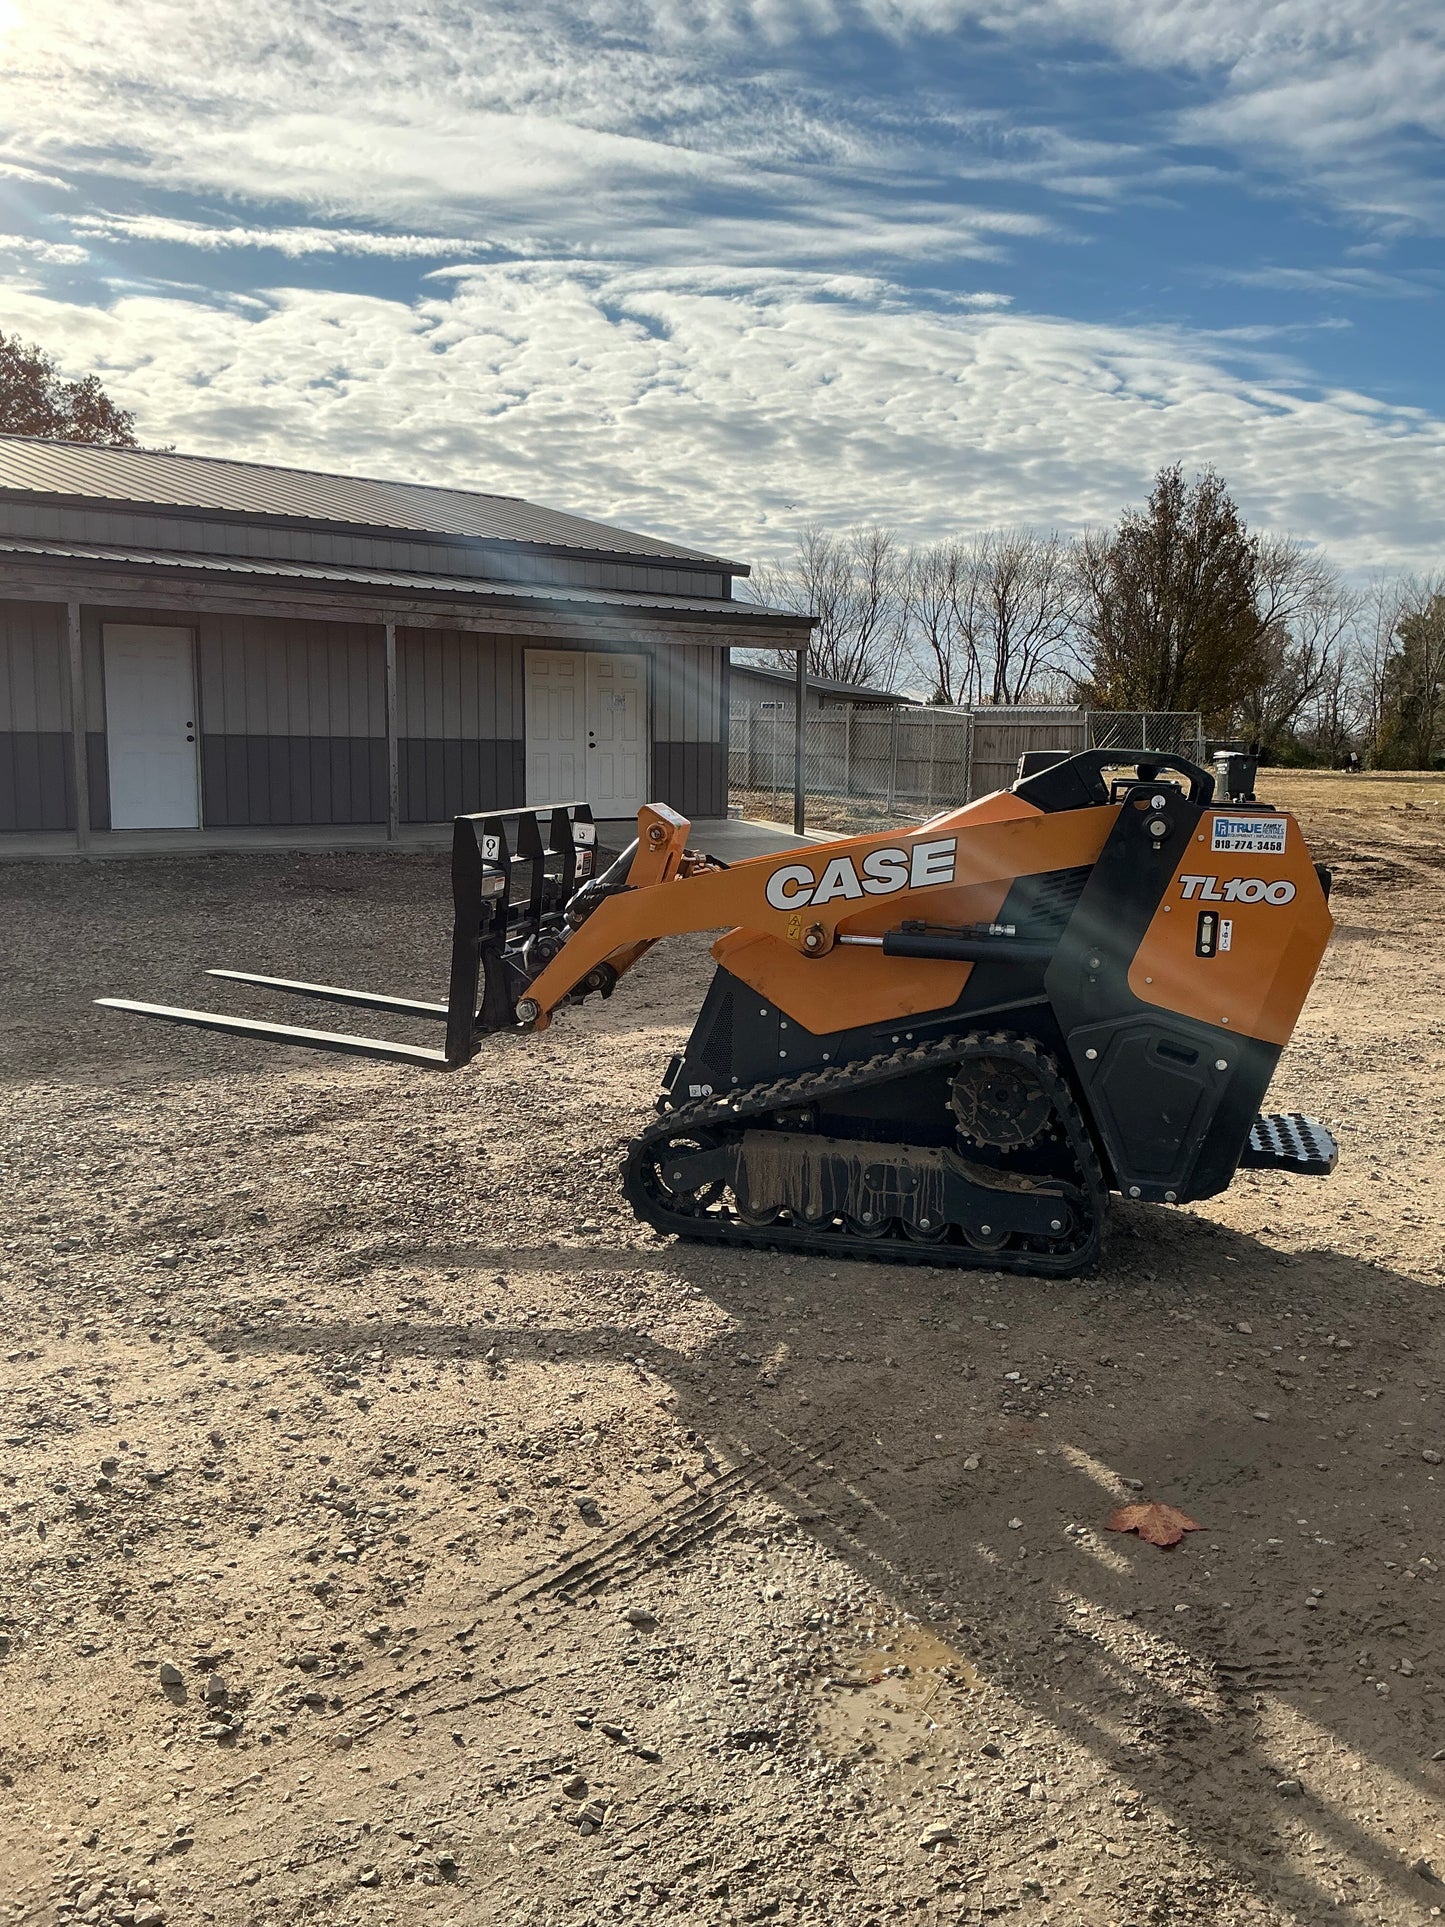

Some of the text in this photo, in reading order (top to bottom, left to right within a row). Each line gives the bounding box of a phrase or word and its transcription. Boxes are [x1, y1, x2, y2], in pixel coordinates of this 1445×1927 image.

[1229, 823, 1262, 833] TRUE
[765, 837, 958, 911] CASE
[1178, 874, 1297, 906] TL100
